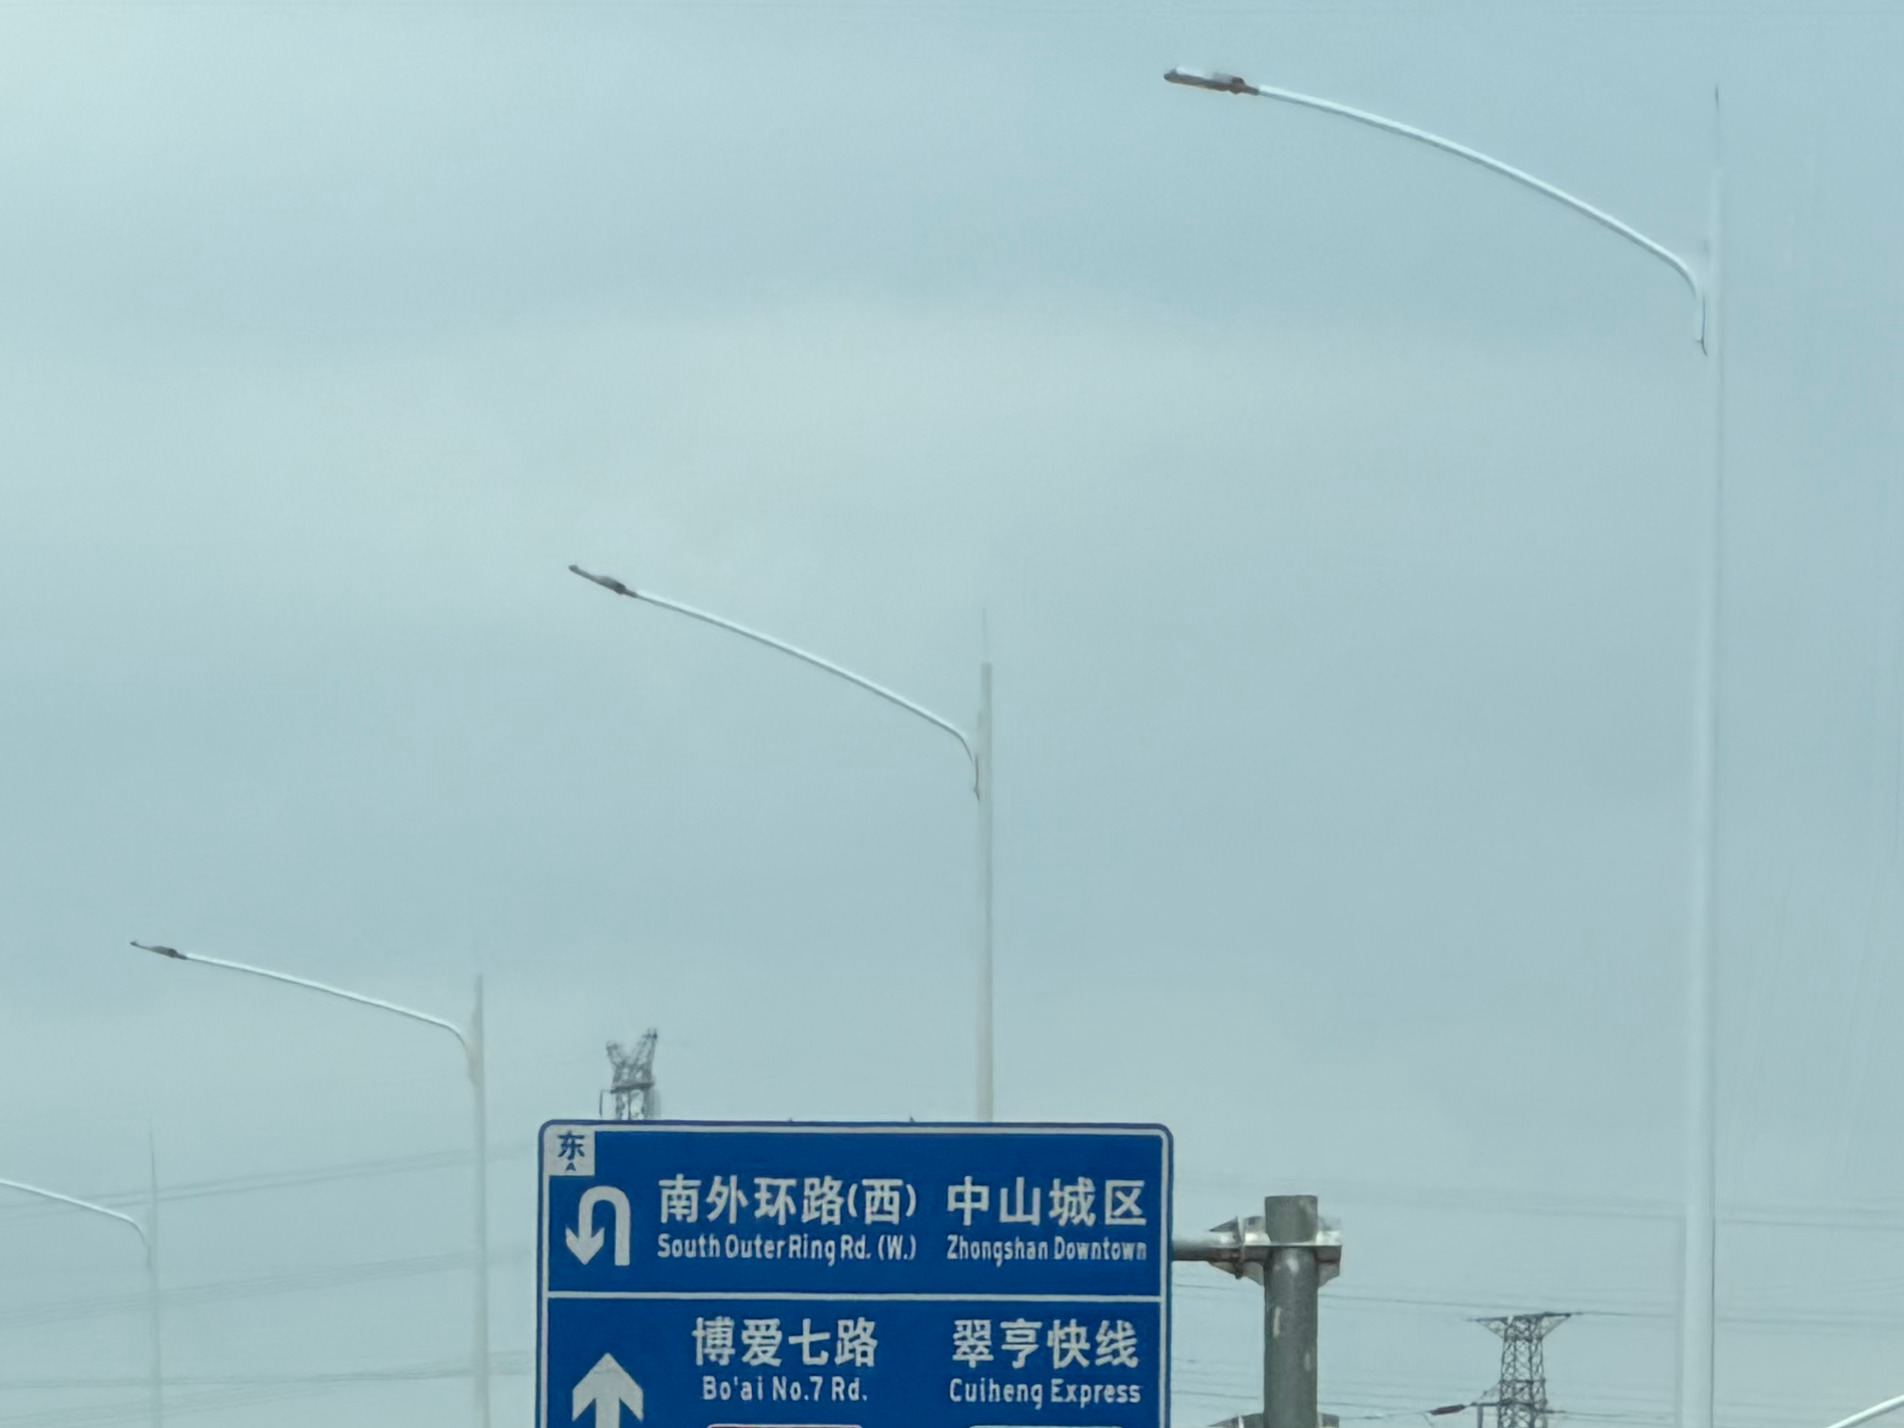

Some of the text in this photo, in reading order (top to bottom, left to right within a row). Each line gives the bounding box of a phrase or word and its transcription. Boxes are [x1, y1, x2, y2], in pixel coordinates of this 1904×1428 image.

[557, 1130, 585, 1161] 东
[658, 1173, 918, 1227] 南外环路(西)
[946, 1177, 1148, 1228] 中山城区
[658, 1233, 918, 1267] South Outer Ring Rd. (W.)
[946, 1234, 1148, 1265] Zhongshan Downtown
[692, 1317, 879, 1369] 博爱七路
[952, 1319, 1140, 1369] 翠亨快线
[703, 1375, 868, 1402] Bo'ai No.7 Rd.
[949, 1378, 1142, 1410] Cuiheng Express
